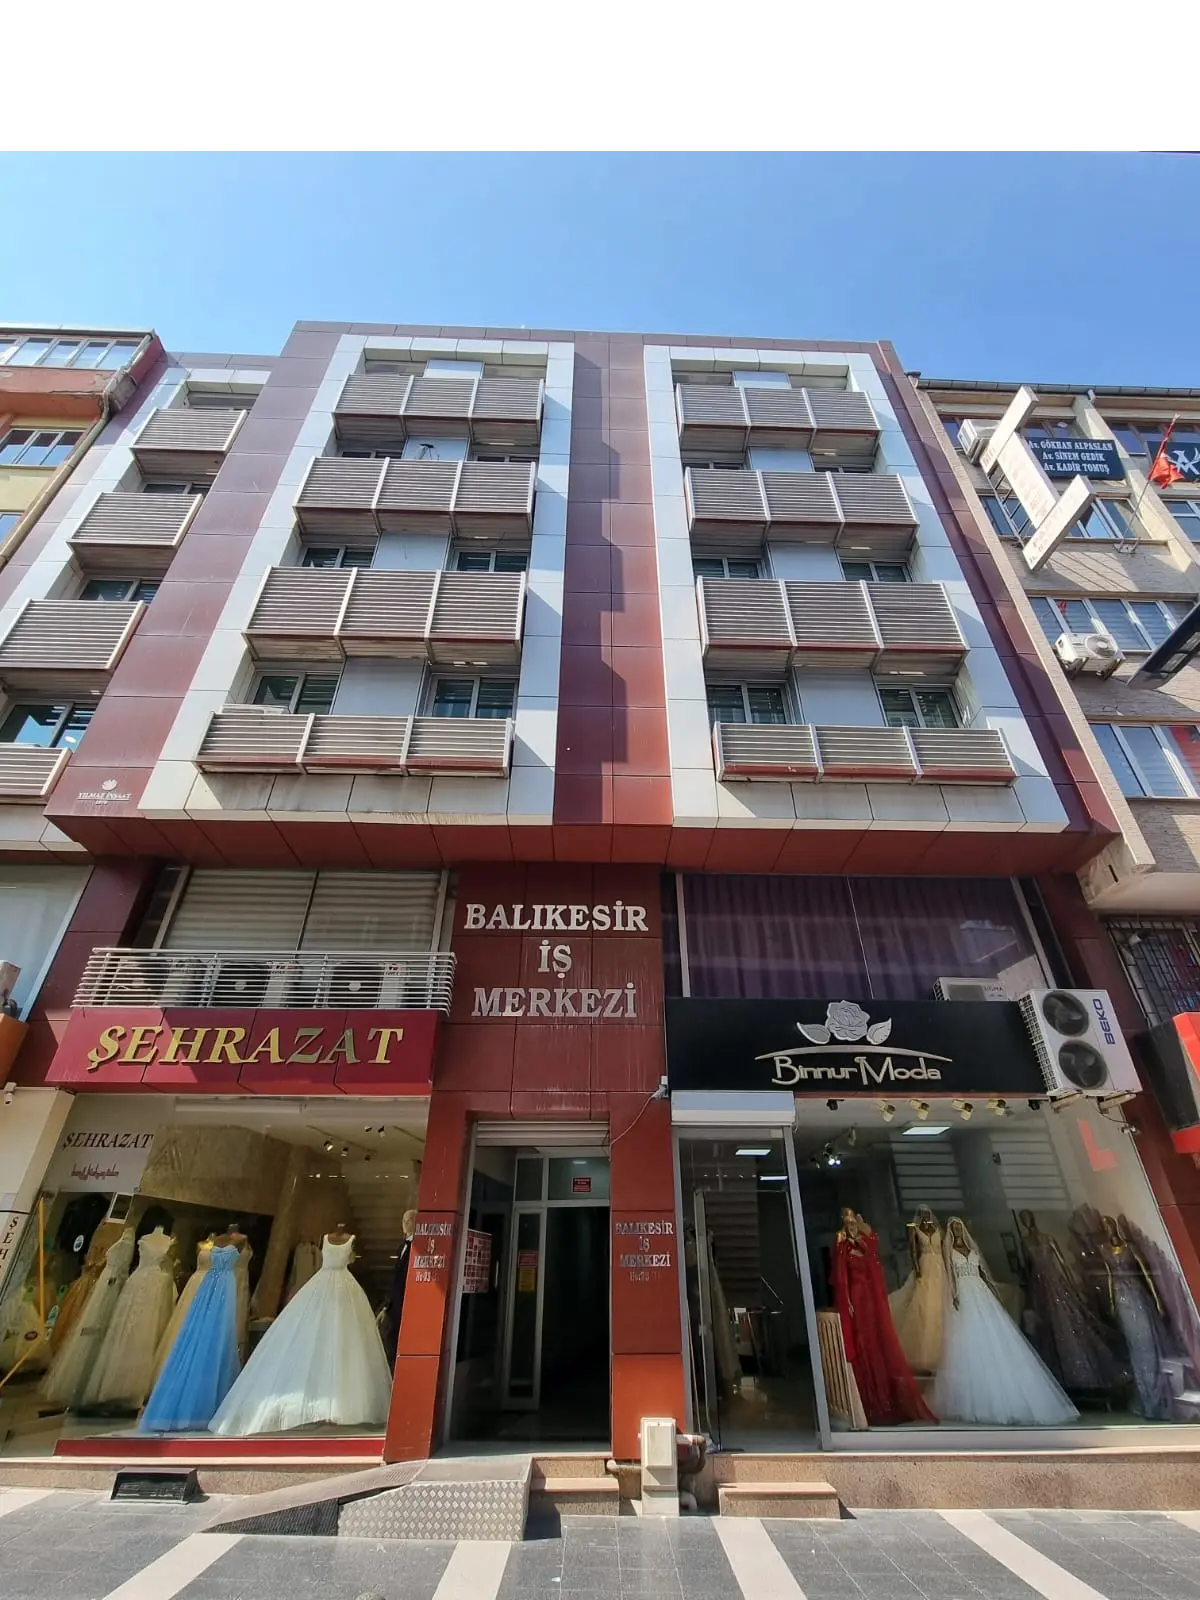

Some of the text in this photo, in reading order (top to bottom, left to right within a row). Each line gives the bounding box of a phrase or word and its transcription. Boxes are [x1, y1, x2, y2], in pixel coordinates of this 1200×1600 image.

[1040, 439, 1073, 450] GÖKHAN
[1074, 441, 1113, 451] ALPASLAN
[1042, 449, 1105, 461] Av. SİNEM GEDİK
[1044, 460, 1110, 475] Av. KADİR TOMUŞ
[464, 900, 649, 931] BALIKESİR
[538, 939, 572, 979] İŞ
[471, 982, 637, 1018] MERKEZİ
[1092, 998, 1116, 1045] BEKO
[87, 1025, 404, 1070] ŞEHRAZAT
[771, 1056, 942, 1086] Binnur Moda
[62, 1132, 154, 1151] ŞEHRAZAT
[615, 1220, 674, 1235] BALIKESİR
[639, 1235, 650, 1253] İŞ
[620, 1250, 671, 1268] MERKEZİ
